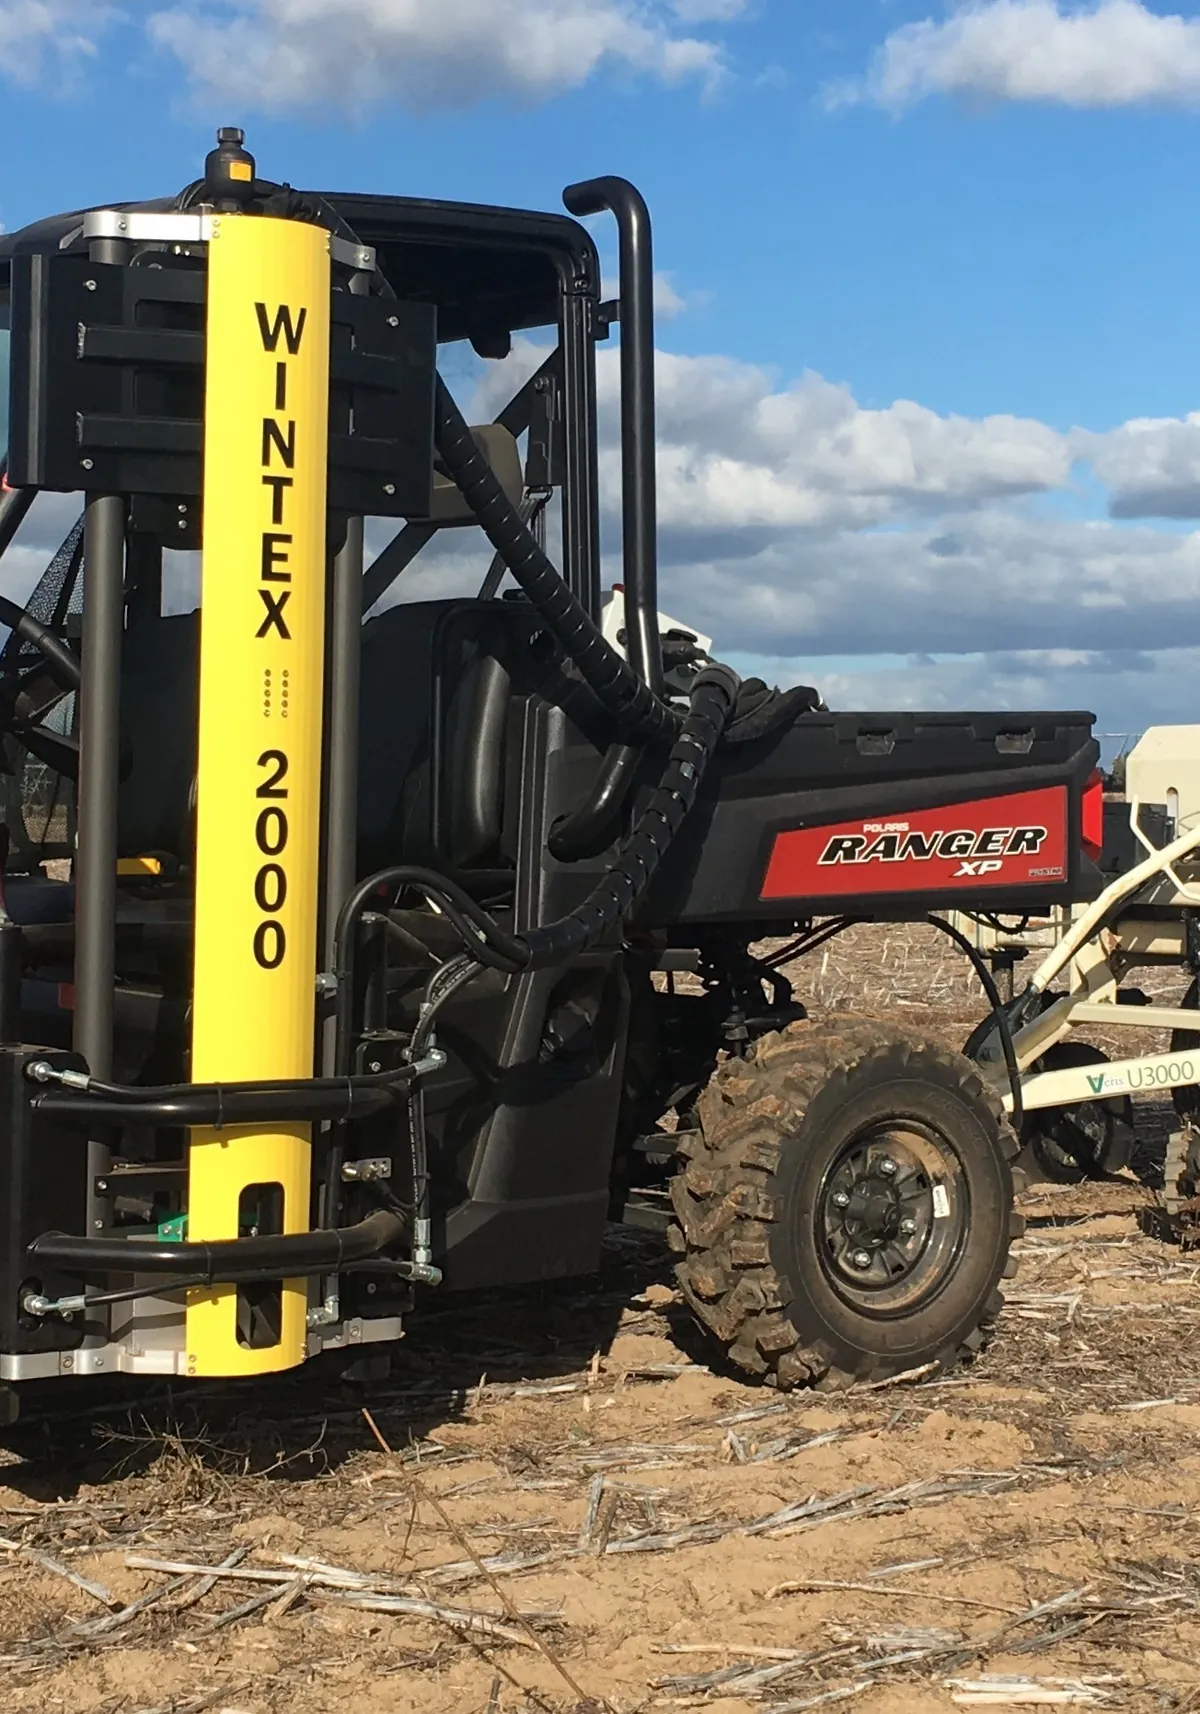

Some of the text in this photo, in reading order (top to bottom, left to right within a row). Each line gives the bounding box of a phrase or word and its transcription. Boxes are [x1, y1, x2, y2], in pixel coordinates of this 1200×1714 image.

[253, 302, 307, 970] WINTEX 2000
[863, 822, 909, 833] POLARIS
[817, 826, 1048, 865] RANGER
[953, 860, 1003, 877] XP
[1086, 1060, 1195, 1094] Veris U3000
